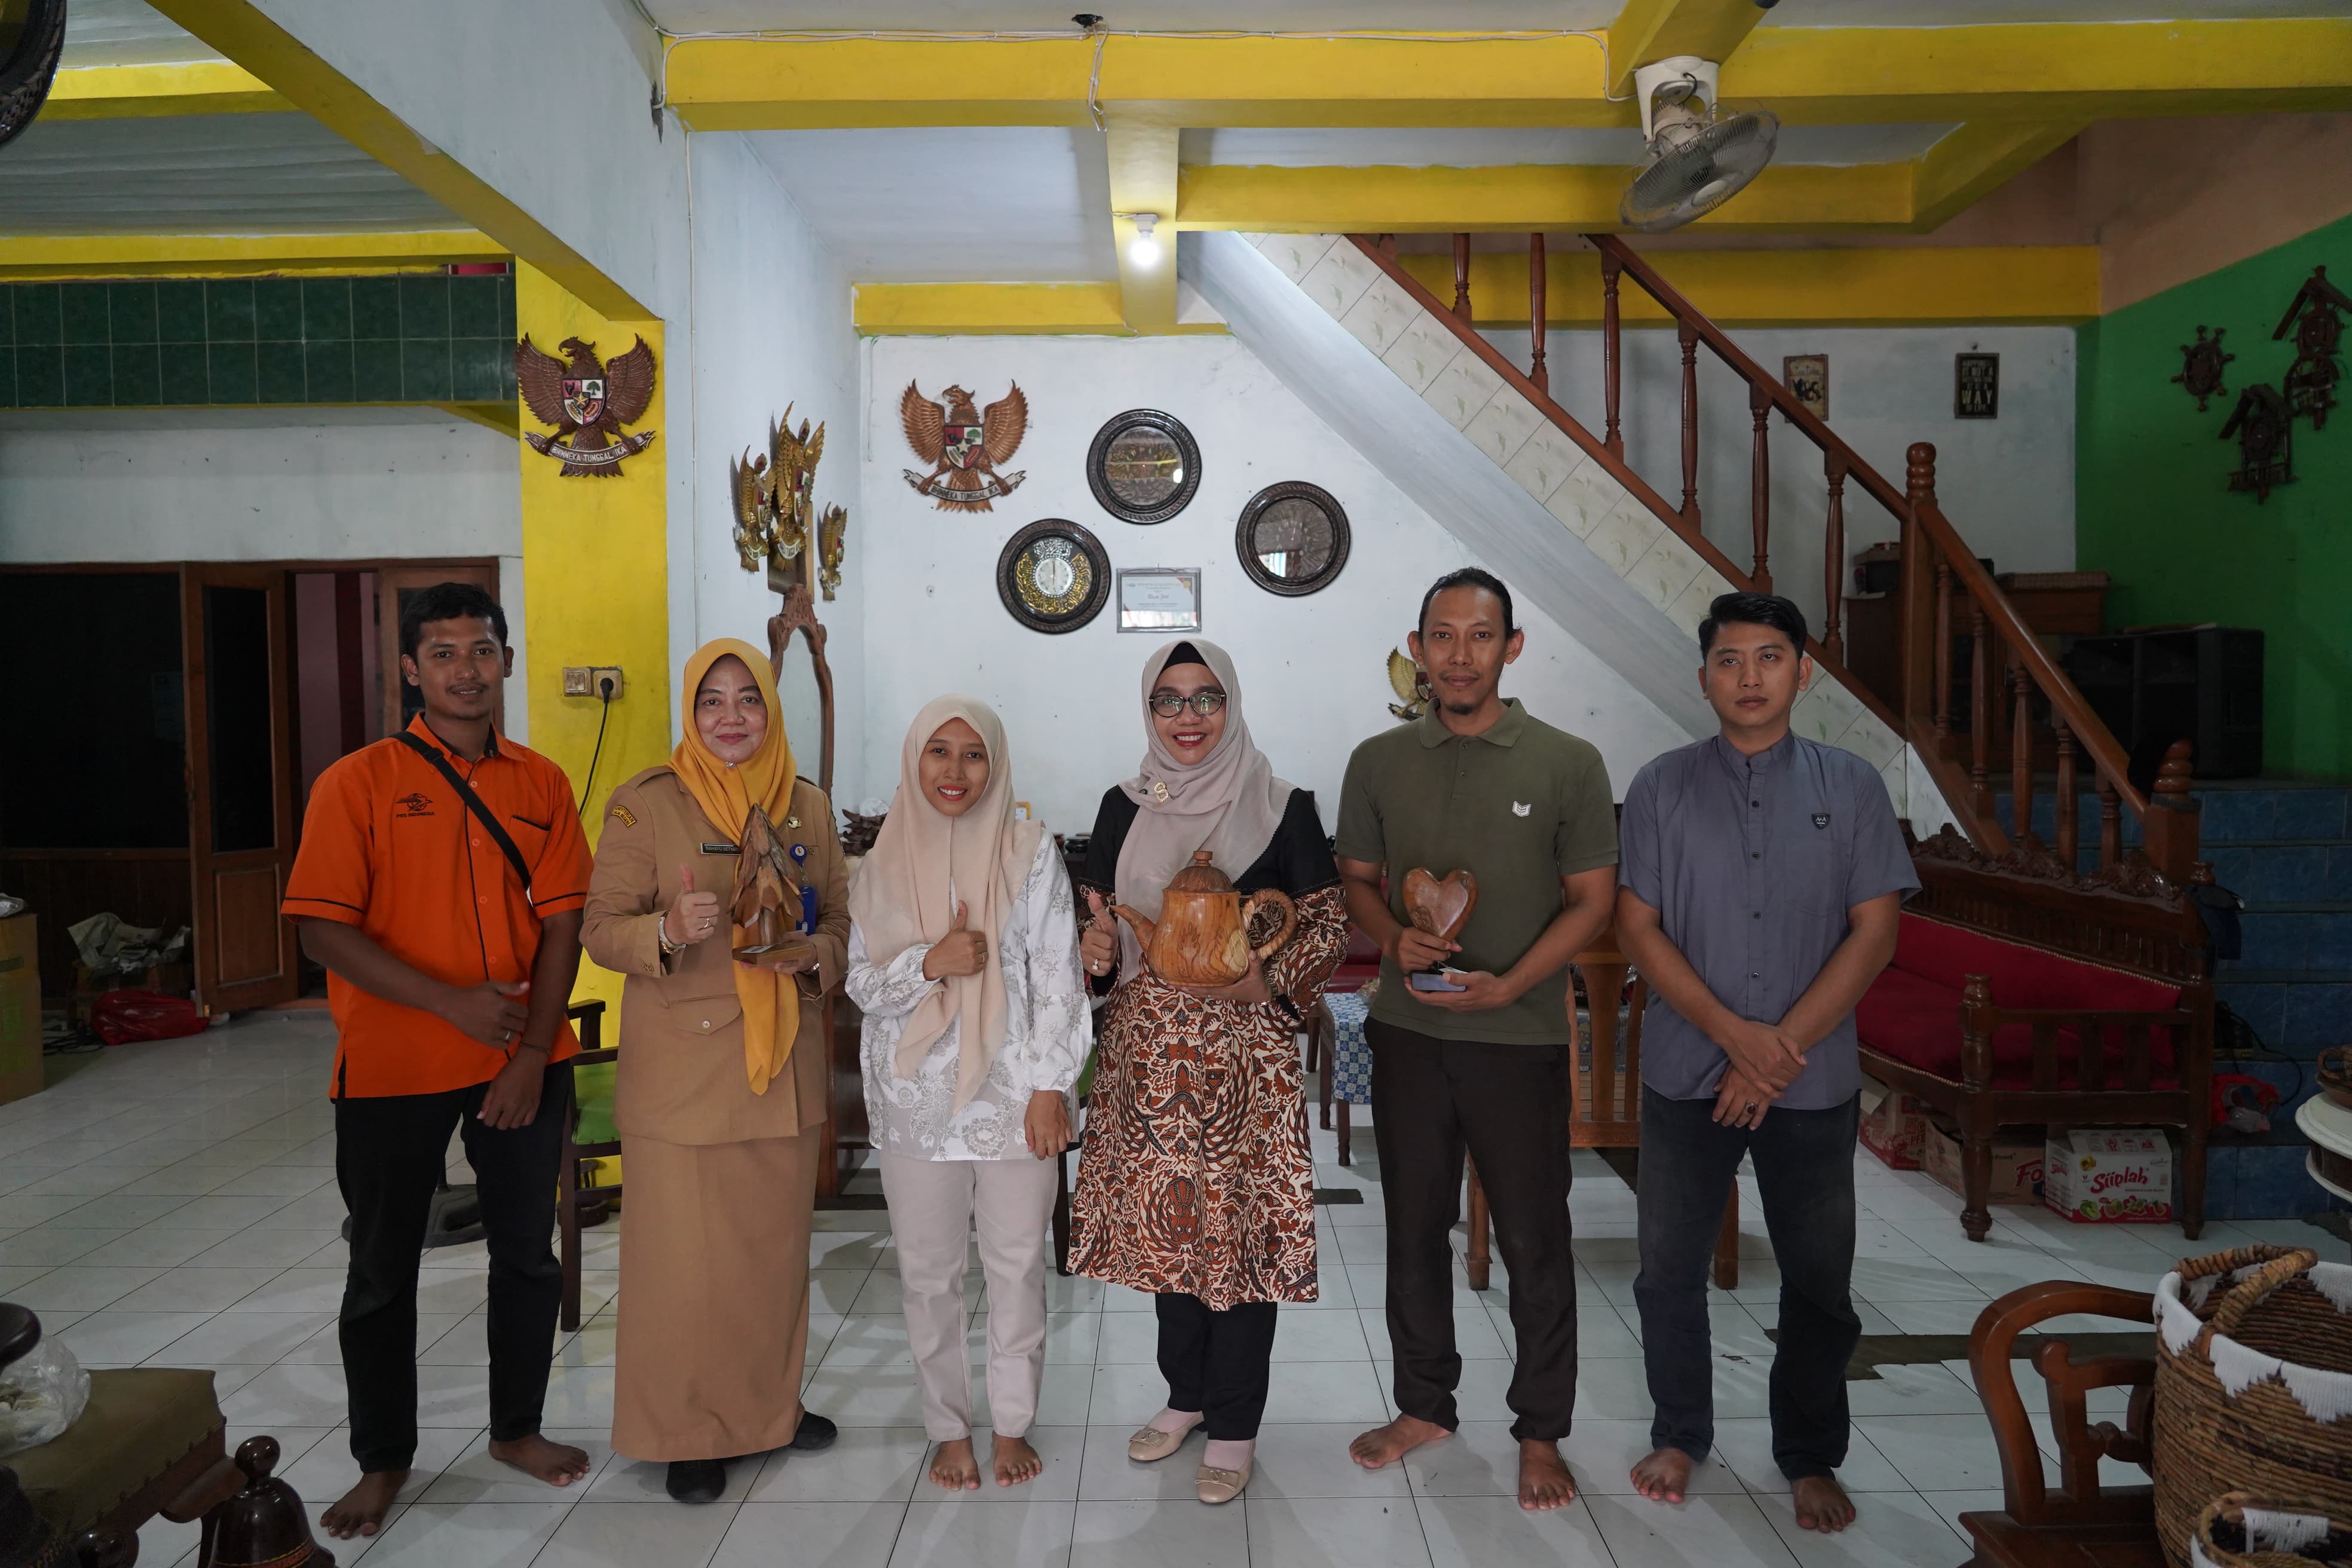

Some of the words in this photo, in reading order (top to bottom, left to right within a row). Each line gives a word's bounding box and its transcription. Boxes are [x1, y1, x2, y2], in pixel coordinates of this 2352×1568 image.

[1961, 390, 1993, 405] WAY
[551, 446, 581, 461] BHINNEKA
[584, 452, 614, 462] TUNGGAL
[614, 445, 627, 457] IKA
[931, 485, 957, 499] BHINNEKA
[960, 491, 986, 500] TUNGGAL
[988, 486, 999, 495] IKA
[2090, 1166, 2148, 1193] Siiplah
